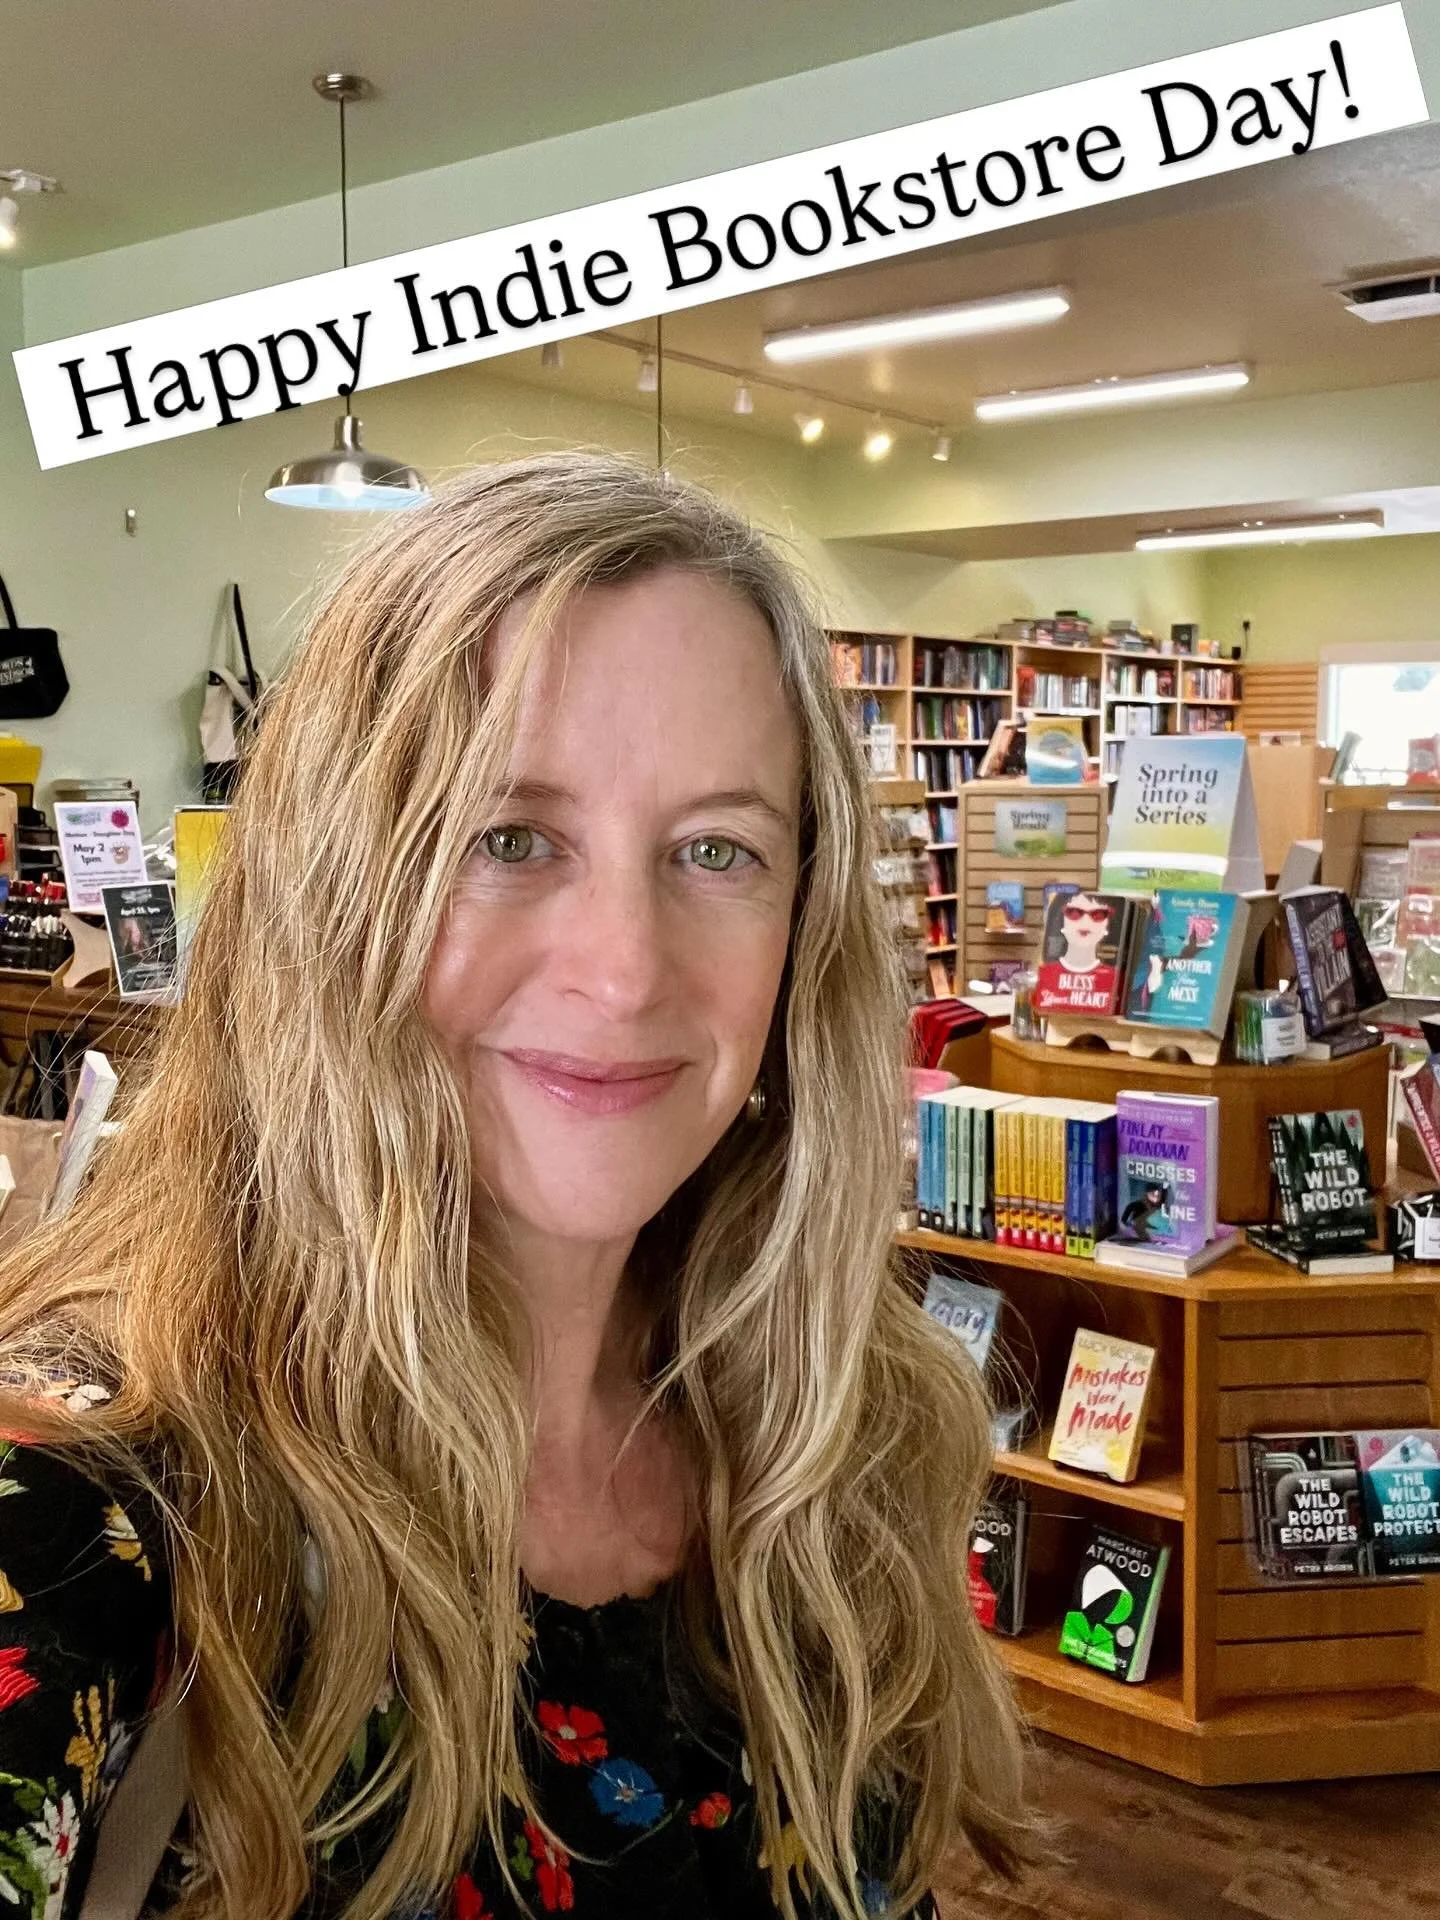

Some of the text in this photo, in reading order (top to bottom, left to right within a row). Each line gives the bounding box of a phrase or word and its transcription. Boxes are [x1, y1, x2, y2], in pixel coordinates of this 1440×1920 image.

[1138, 763, 1219, 788] Spring
[1142, 784, 1208, 805] into a
[1135, 804, 1208, 826] Series
[73, 842, 105, 855] May 2
[81, 855, 103, 866] 1pm
[1165, 959, 1213, 976] ANOTHER
[1058, 973, 1097, 991] BLESS
[1069, 990, 1111, 1009] HEART
[1119, 1118, 1167, 1140] FINLAY
[1127, 1136, 1191, 1161] DONOVAN
[1308, 1148, 1349, 1168] THE
[1125, 1160, 1197, 1184] CROSSES
[1303, 1166, 1361, 1191] WILD
[1300, 1187, 1369, 1213] ROBOT
[1160, 1202, 1198, 1223] LINE
[1067, 1361, 1147, 1391] Mistakes
[1067, 1401, 1133, 1438] Made
[1298, 1477, 1332, 1493] THE
[1391, 1471, 1425, 1486] THE
[1293, 1491, 1341, 1510] WILD
[1387, 1485, 1432, 1503] WILD
[1287, 1508, 1348, 1527] ROBOT
[1382, 1502, 1440, 1521] ROBOT
[1279, 1525, 1358, 1545] ESCAPES
[1373, 1518, 1440, 1537] PROTECT
[1097, 1535, 1149, 1561] MARGARET
[1086, 1543, 1153, 1578] ATWOOD
